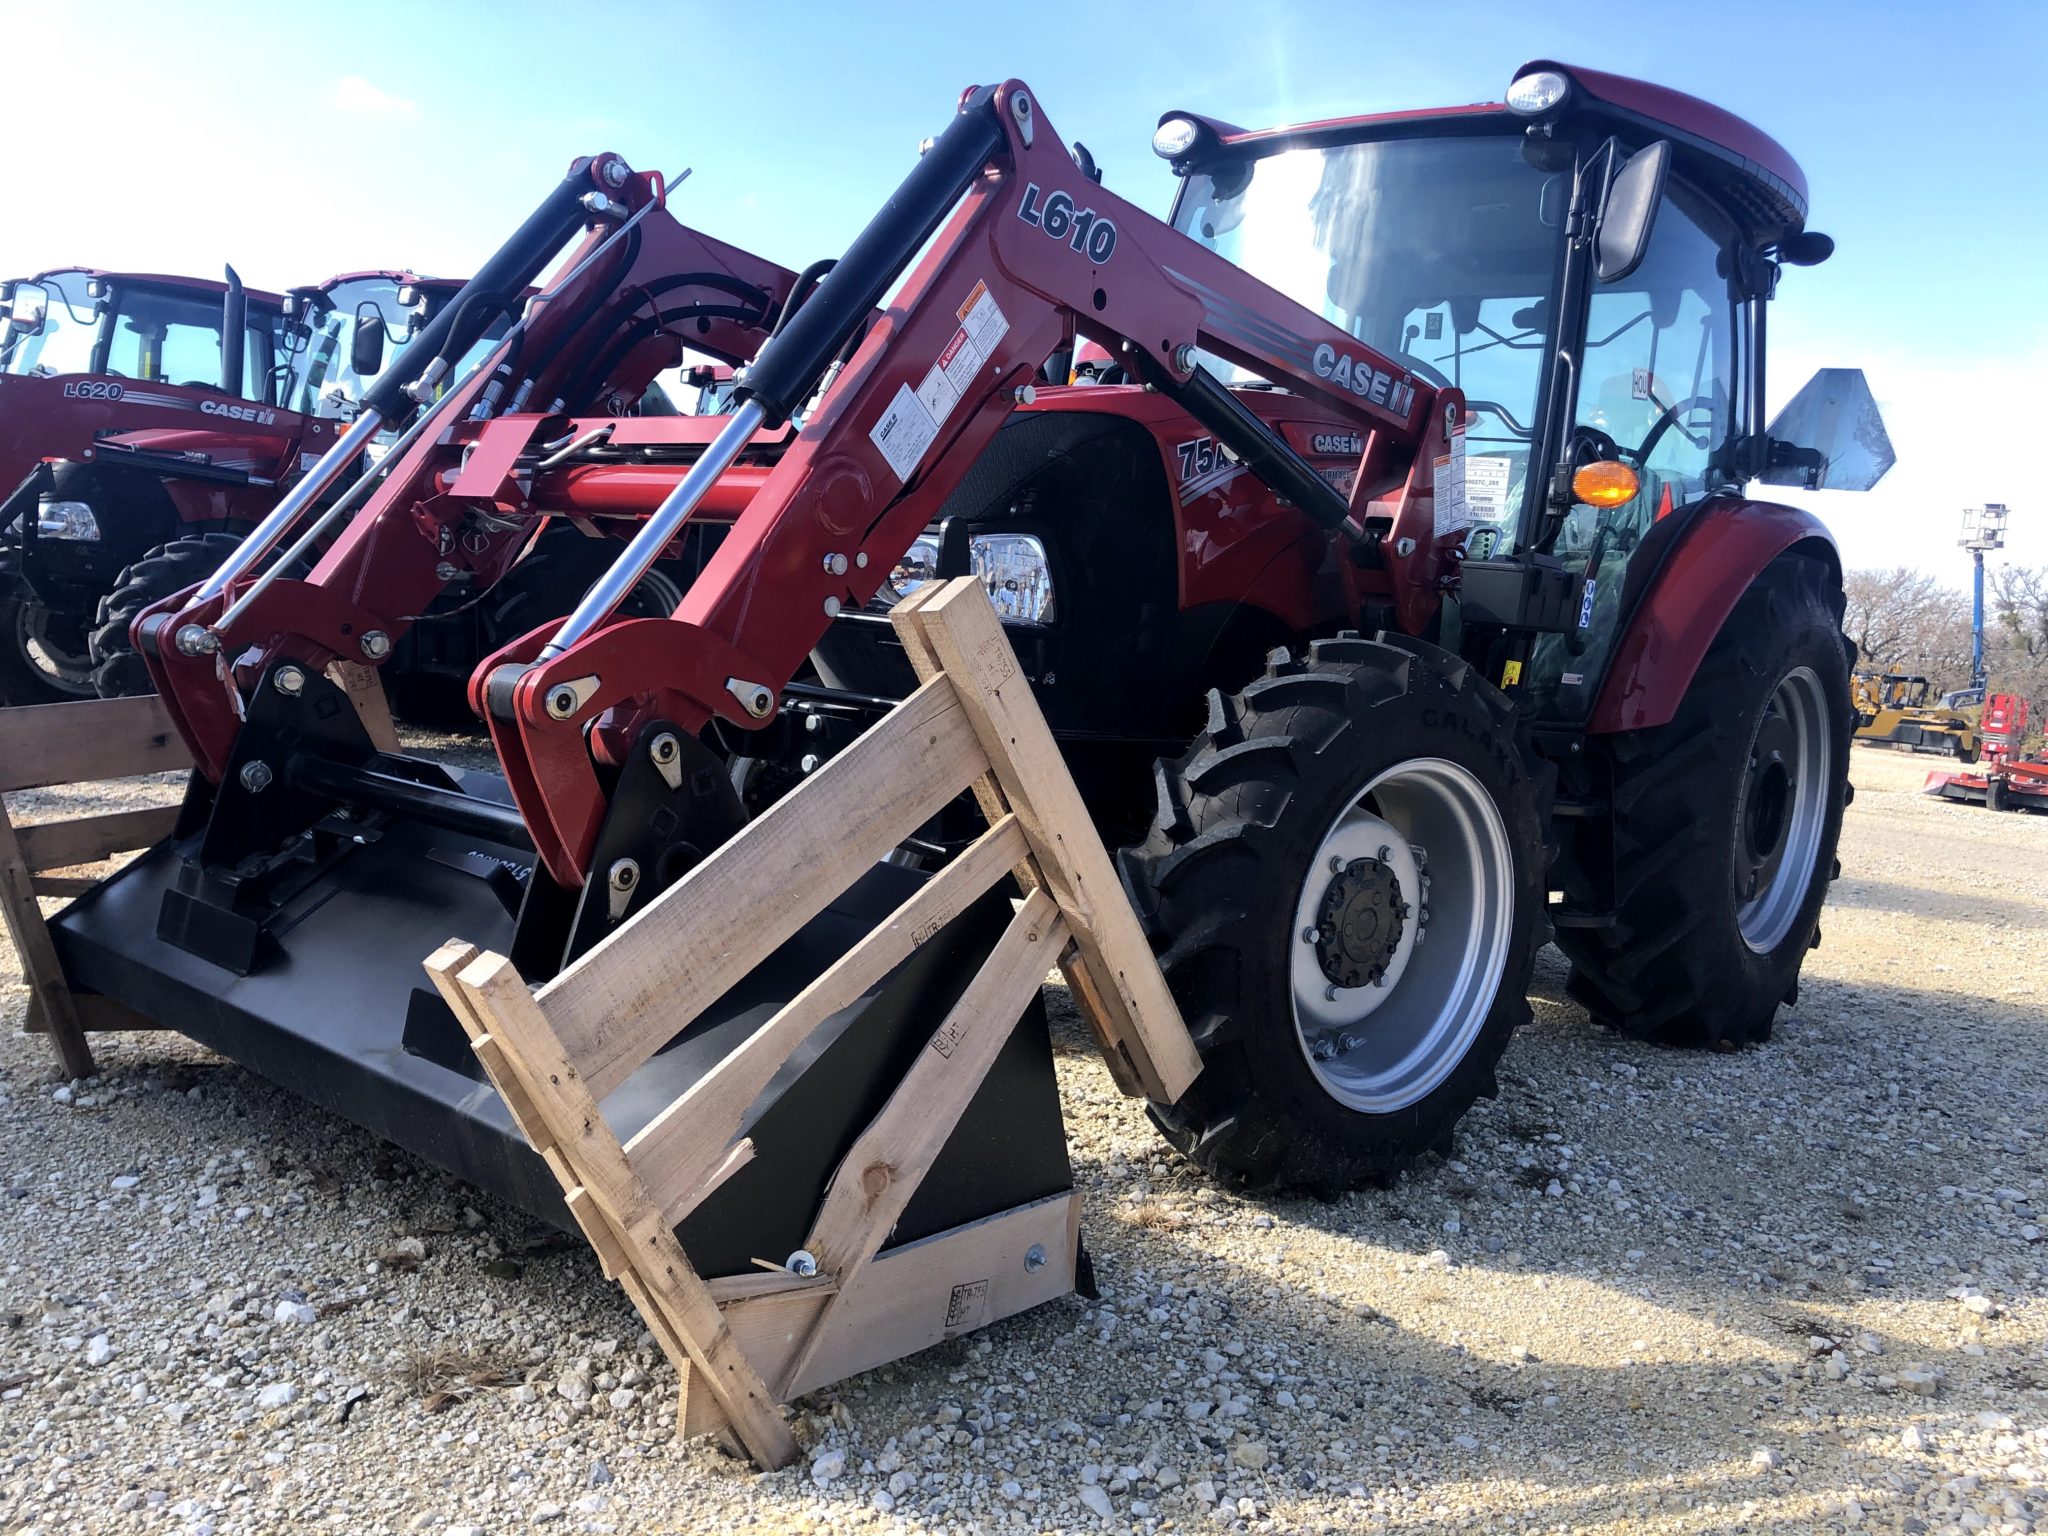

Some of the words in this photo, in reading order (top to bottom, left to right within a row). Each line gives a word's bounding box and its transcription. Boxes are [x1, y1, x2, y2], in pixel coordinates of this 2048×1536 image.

[1017, 182, 1116, 264] L610
[945, 332, 966, 360] DANGER
[1313, 343, 1390, 405] CASE
[64, 381, 124, 401] L620
[200, 400, 256, 421] CASE
[1314, 435, 1349, 453] CASE
